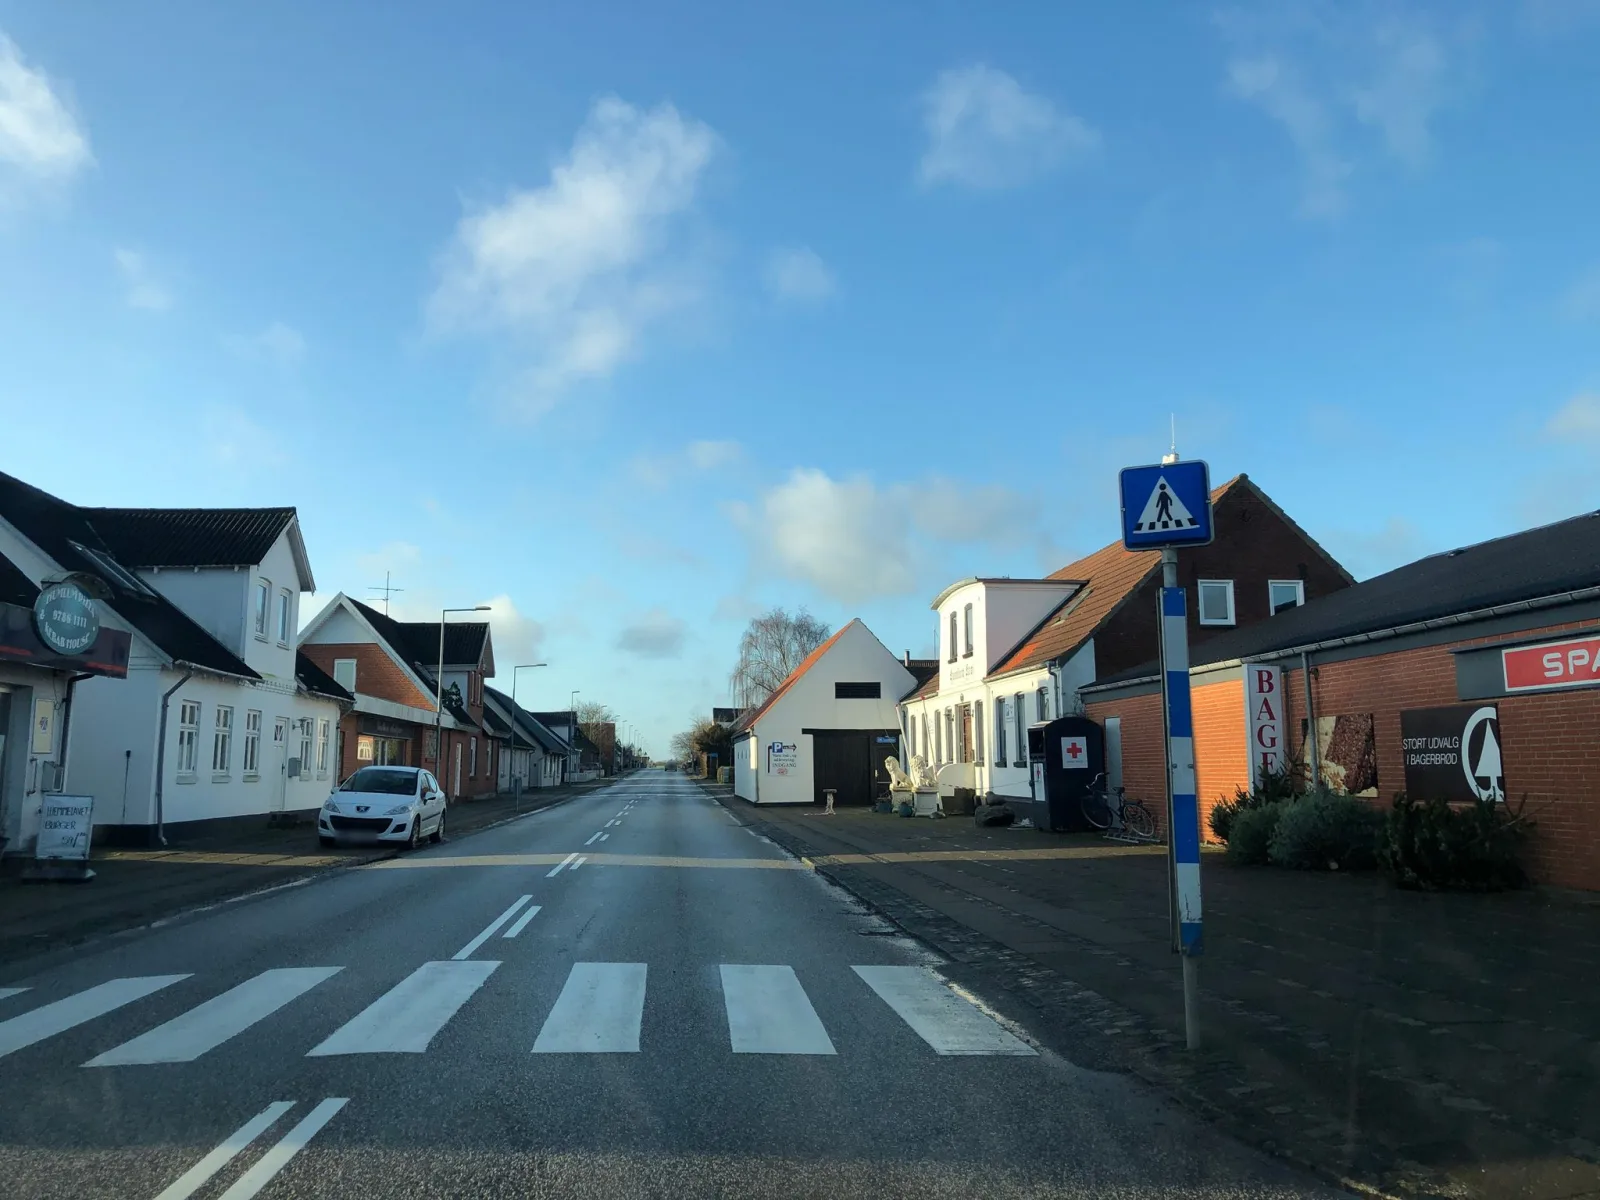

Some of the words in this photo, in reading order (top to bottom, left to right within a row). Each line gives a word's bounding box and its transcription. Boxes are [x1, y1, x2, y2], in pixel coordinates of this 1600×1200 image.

[73, 615, 87, 628] 1111
[45, 621, 66, 647] KEBAB
[1402, 737, 1427, 750] STORT
[1428, 736, 1460, 749] UDVALG
[1406, 754, 1410, 765] I
[1410, 753, 1458, 765] BAGERBRØD
[44, 820, 77, 830] BURGER
